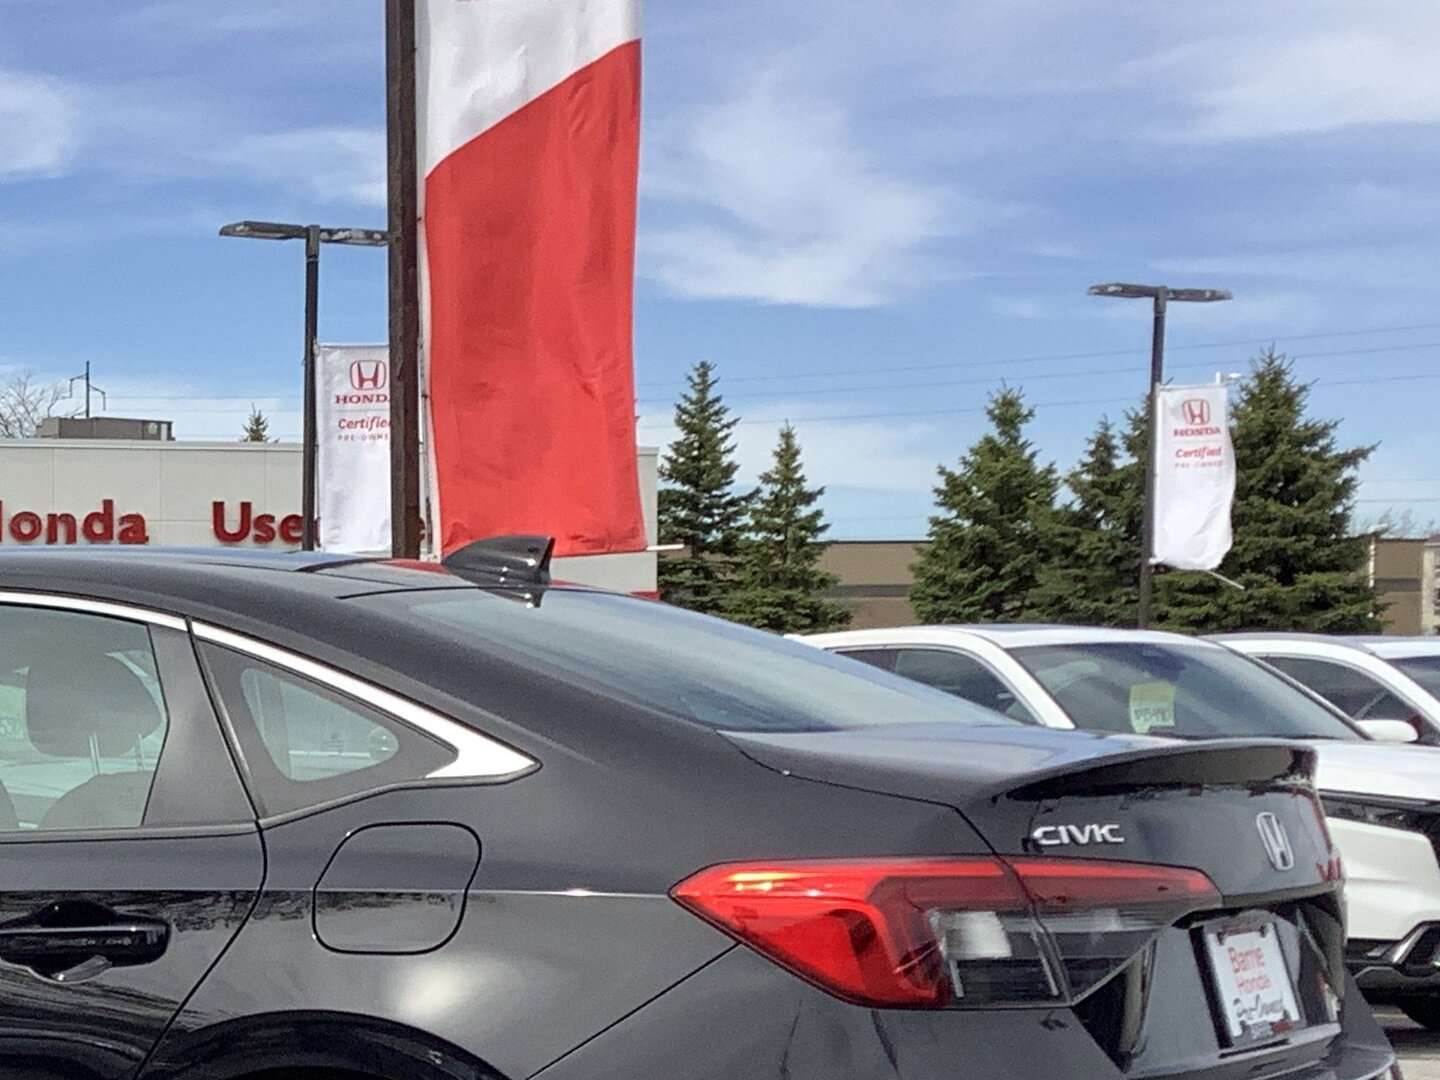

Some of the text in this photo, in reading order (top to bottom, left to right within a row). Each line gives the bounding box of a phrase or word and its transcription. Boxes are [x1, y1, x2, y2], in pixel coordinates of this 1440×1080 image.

[336, 394, 390, 404] HOND
[338, 416, 391, 431] Certifie
[1174, 427, 1221, 436] HONDA
[1175, 446, 1222, 459] Certified
[212, 501, 321, 545] Use
[1033, 824, 1125, 845] CIVIC
